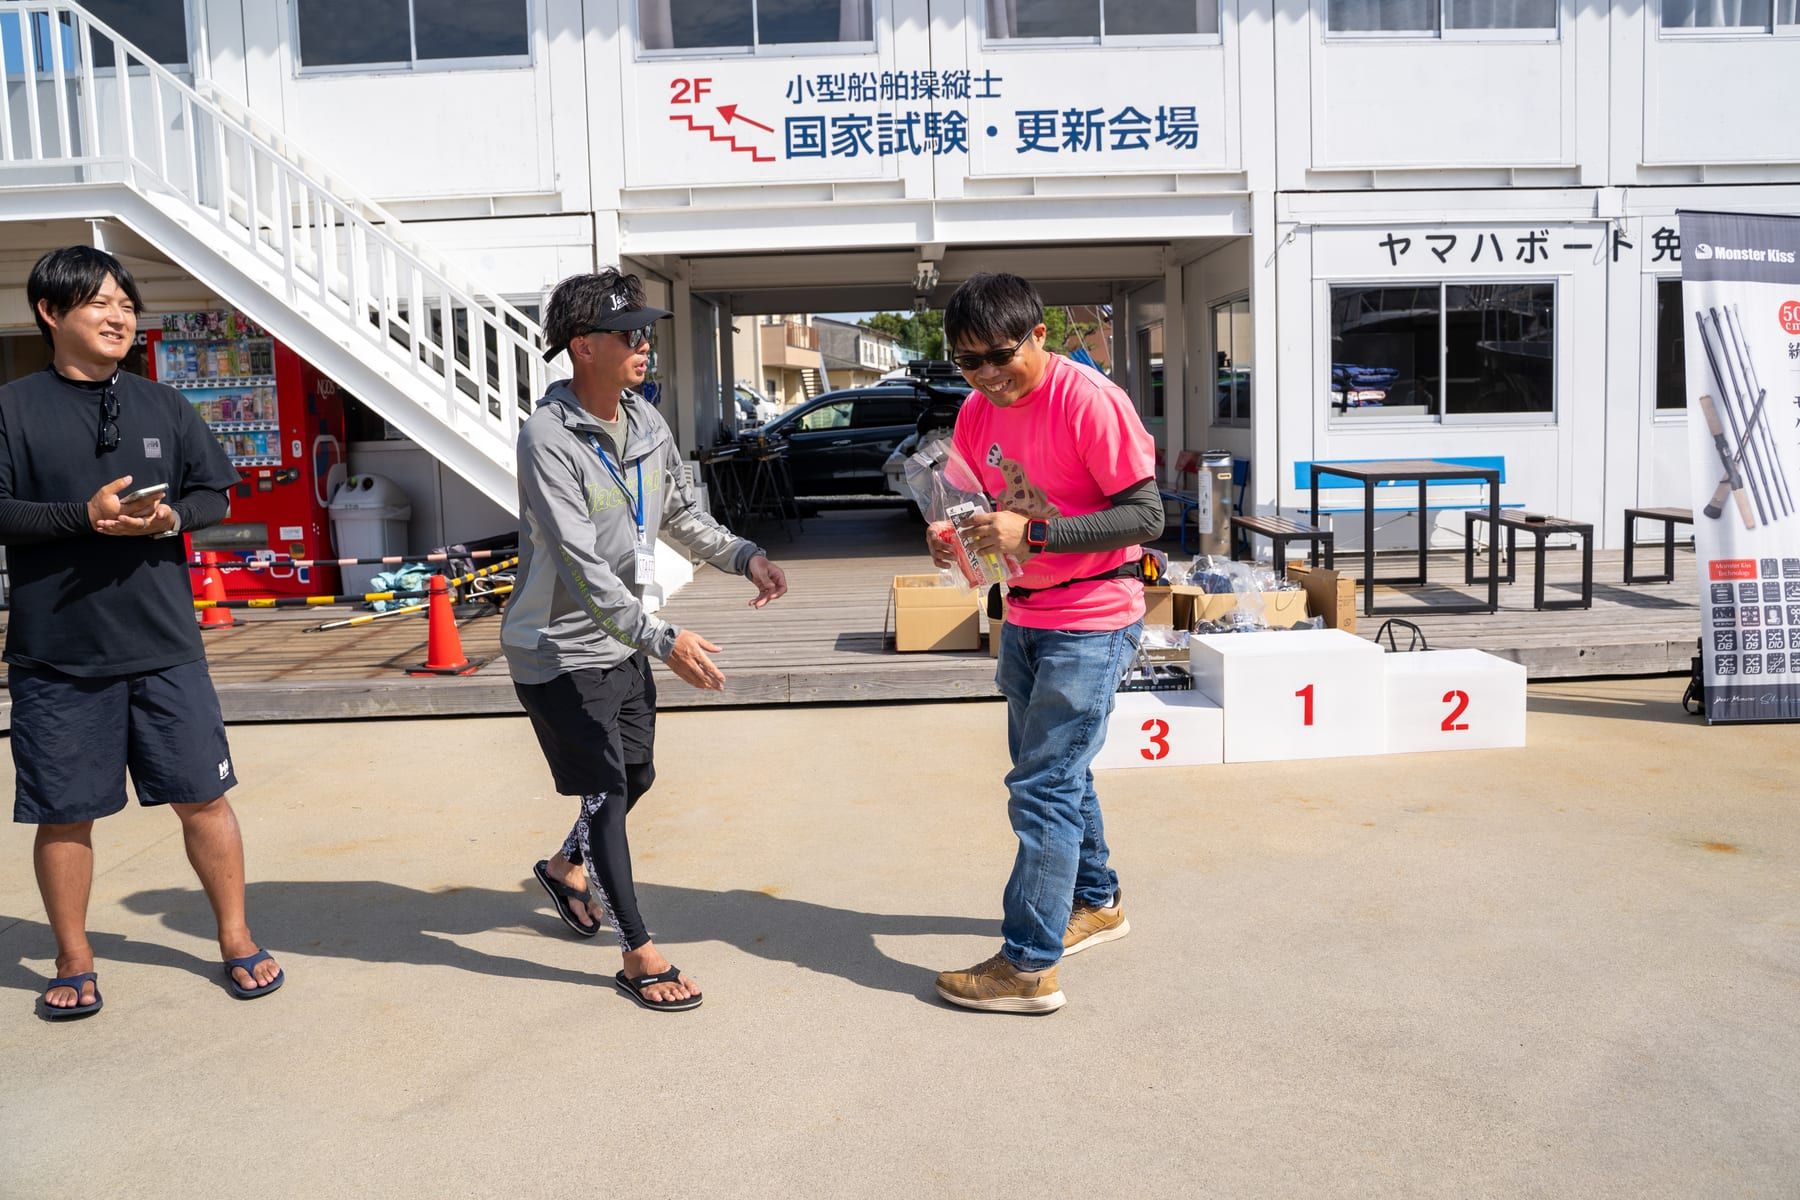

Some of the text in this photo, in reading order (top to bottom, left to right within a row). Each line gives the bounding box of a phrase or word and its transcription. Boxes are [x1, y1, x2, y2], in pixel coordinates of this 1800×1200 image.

[669, 77, 713, 104] 2F
[785, 70, 1003, 104] 小型船舶操縦士
[783, 105, 1200, 159] 国家試験・更新会場
[1714, 246, 1767, 262] Monster
[1295, 684, 1314, 726] 1
[1441, 690, 1470, 731] 2
[1140, 718, 1170, 761] 3
